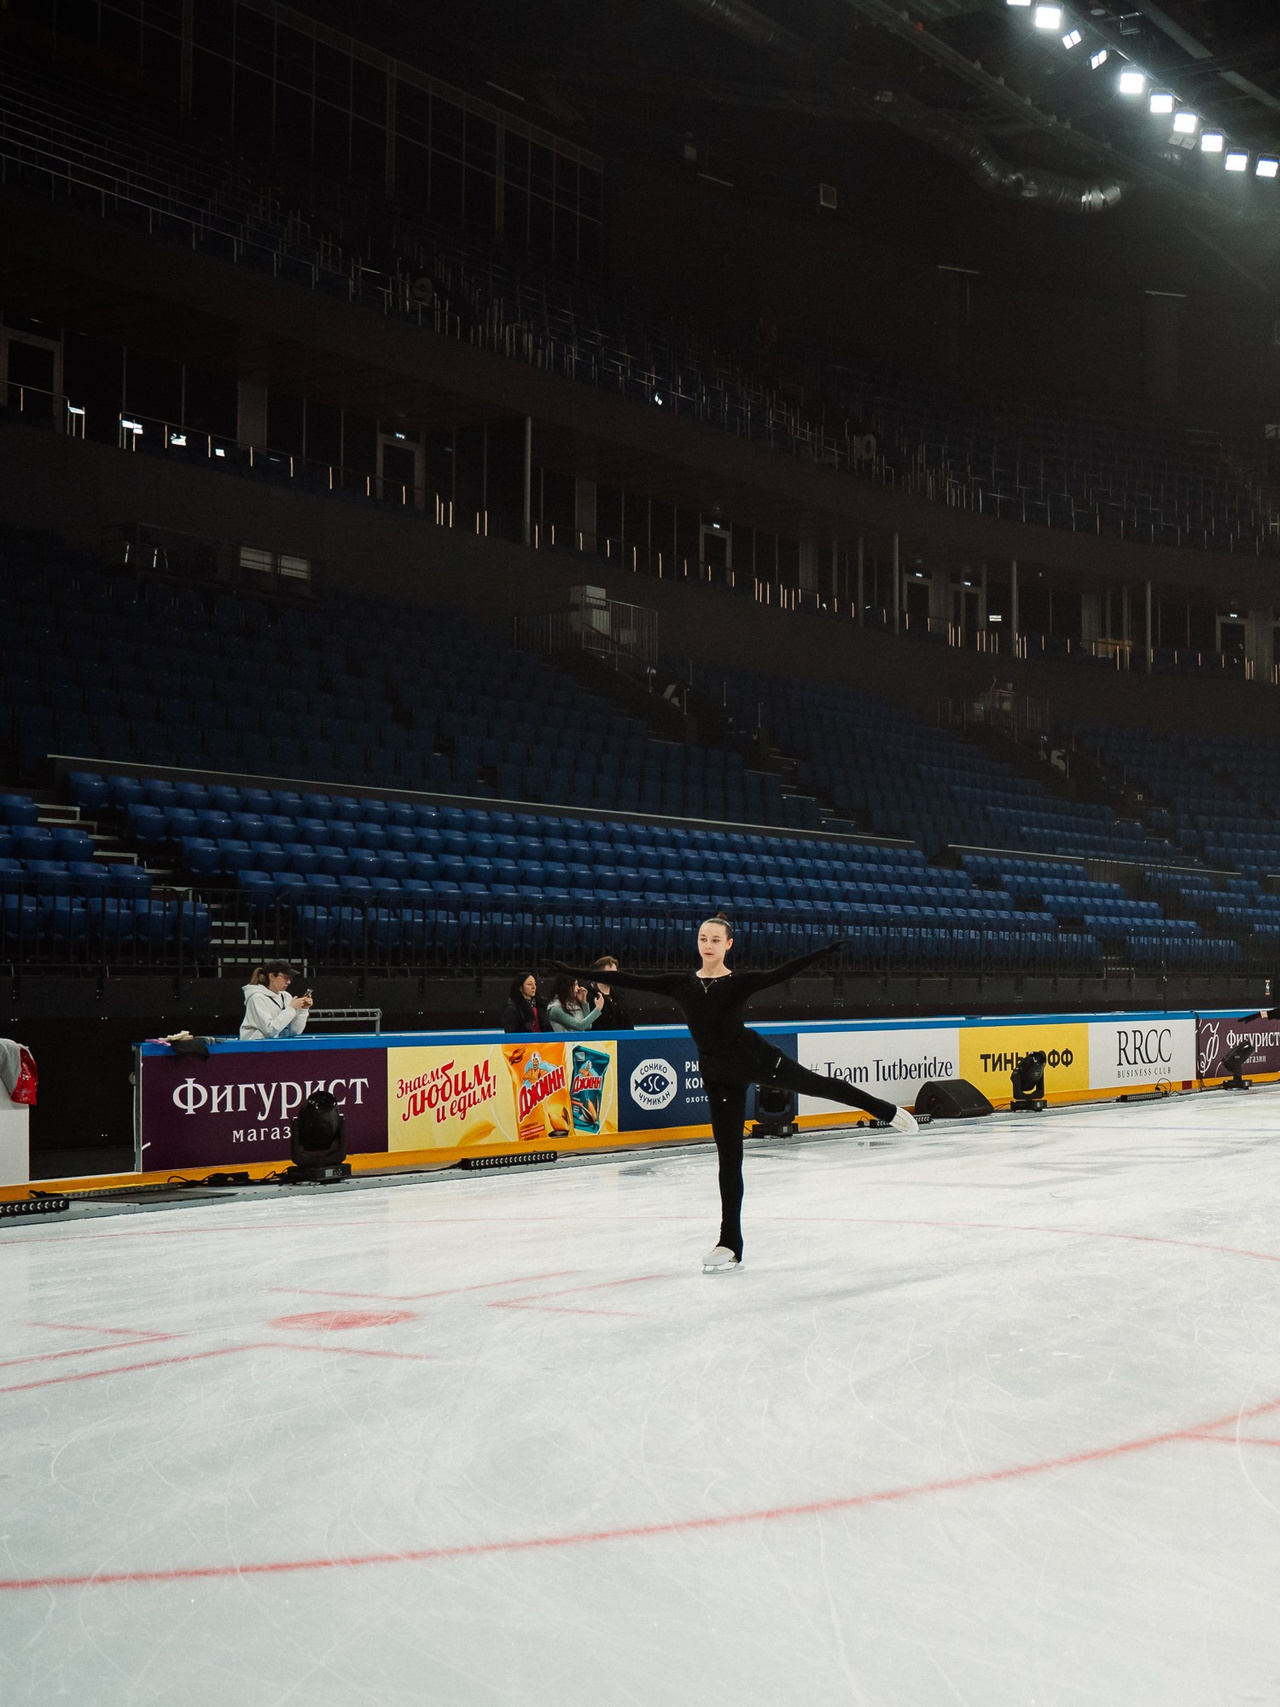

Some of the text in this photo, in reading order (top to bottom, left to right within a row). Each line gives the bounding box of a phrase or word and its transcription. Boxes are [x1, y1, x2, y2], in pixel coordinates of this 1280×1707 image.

[1117, 1028, 1172, 1066] RRCC
[1226, 1029, 1280, 1053] Фигурист
[640, 1062, 668, 1076] СОНИКО
[824, 1061, 869, 1083] Team
[873, 1055, 953, 1083] Tutberidze
[980, 1048, 1073, 1072] ТИНЬФФ
[1244, 1055, 1267, 1064] агазин
[396, 1068, 443, 1099] Знаем,
[1118, 1067, 1171, 1078] BUSINESS CLUB
[172, 1077, 369, 1121] Фигурист
[402, 1059, 490, 1122] любим
[436, 1075, 497, 1123] и едим!
[639, 1091, 671, 1106] ЧУМИКАН
[686, 1096, 709, 1104] охотс
[232, 1126, 292, 1143] магаз
